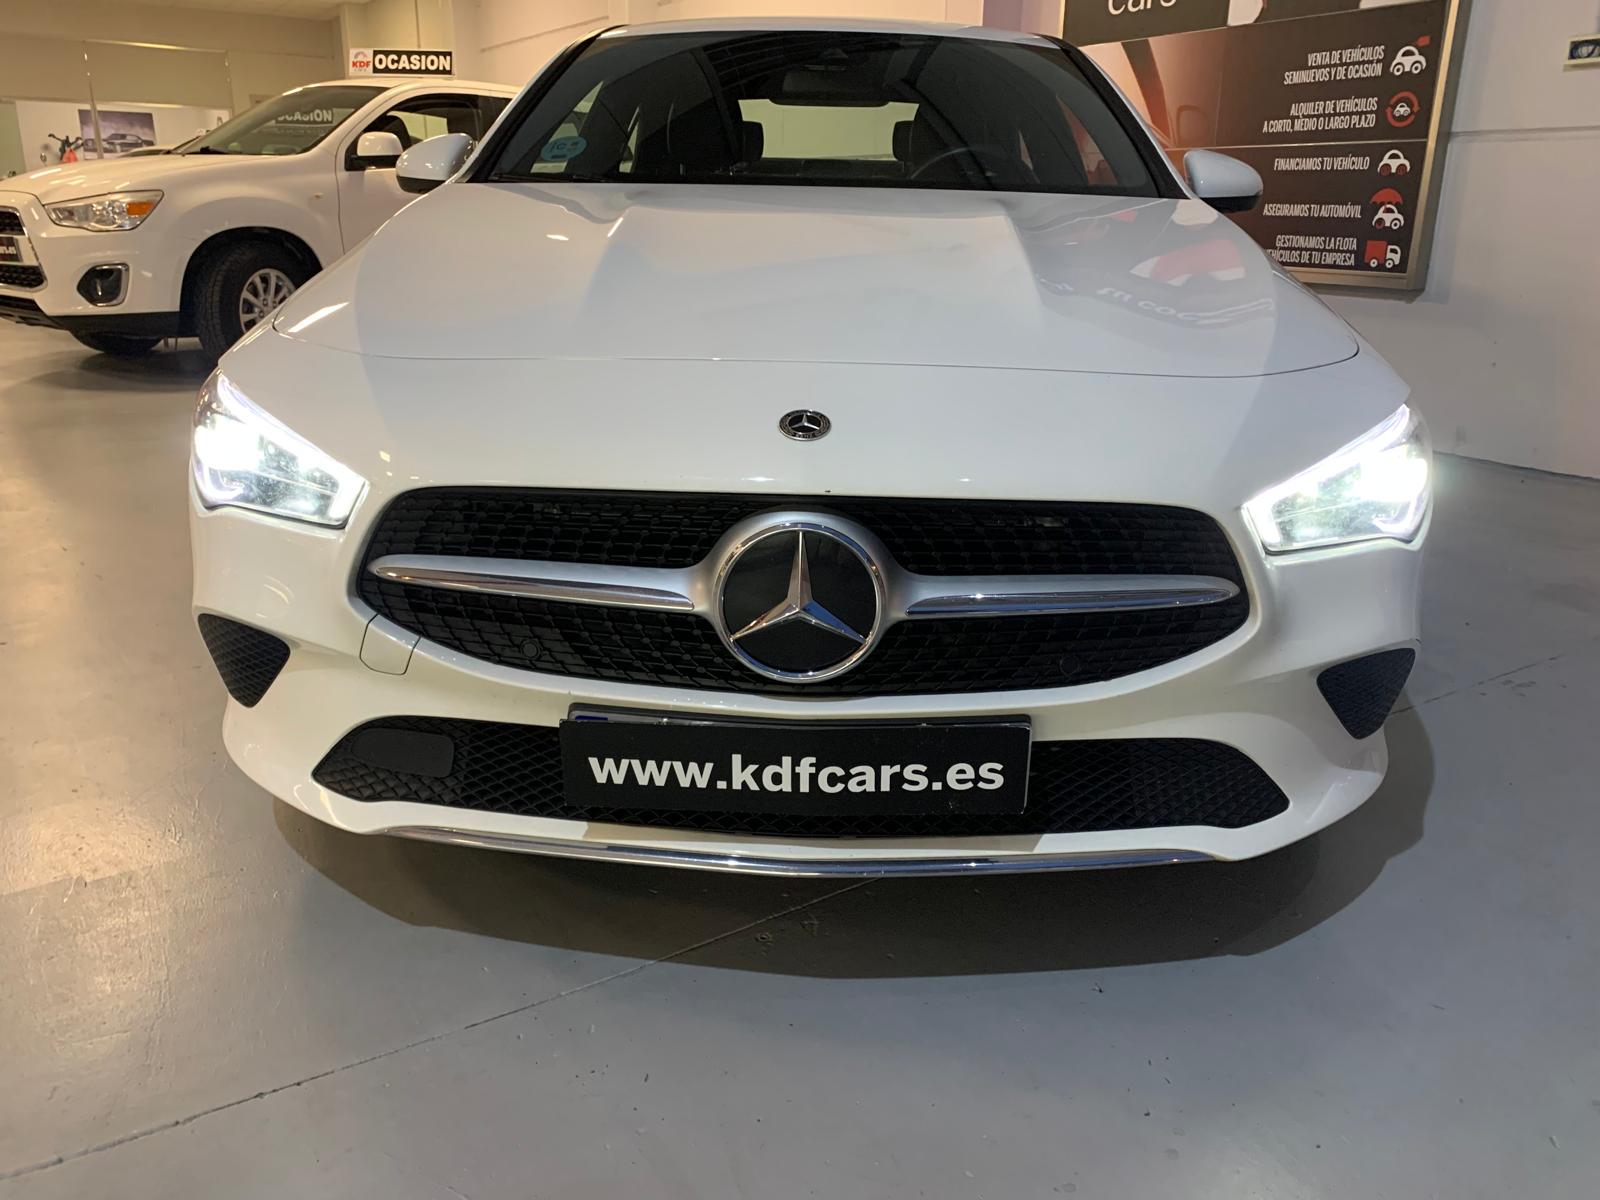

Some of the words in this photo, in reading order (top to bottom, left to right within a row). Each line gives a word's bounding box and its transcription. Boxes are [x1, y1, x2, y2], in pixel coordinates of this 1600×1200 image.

[351, 60, 371, 68] KDF
[374, 54, 451, 70] OCASION
[1307, 51, 1330, 66] VENTA
[1331, 50, 1340, 63] DE
[1340, 45, 1385, 62] VEHÍCULOS
[1284, 68, 1329, 85] SEMINUEVOS
[1330, 67, 1336, 80] Y
[1336, 66, 1347, 80] DE
[1347, 60, 1383, 78] OCASIÓN
[1290, 101, 1324, 118] ALQUILER
[1325, 100, 1335, 114] DE
[1336, 95, 1378, 113] VEHÍCULOS
[1262, 121, 1268, 133] A
[1268, 119, 1293, 133] CORTO,
[1293, 117, 1317, 131] MEDIO
[1318, 117, 1324, 130] O
[1324, 115, 1350, 130] LARGO
[1350, 114, 1376, 128] PLAZO
[1274, 157, 1322, 171] FINANCIAMOS
[1323, 157, 1333, 170] TU
[1333, 153, 1370, 170] VEHÍCULO
[1263, 203, 1311, 217] ASEGURAMOS
[1311, 204, 1320, 217] TU
[1320, 202, 1361, 218] AUTOMÓVIL
[1275, 234, 1325, 249] GESTIONAMOS
[1325, 237, 1335, 249] LA
[1335, 237, 1357, 250] FLOTA
[1301, 251, 1311, 263] DE
[1311, 251, 1321, 264] TU
[1321, 252, 1355, 266] EMPRESA
[588, 753, 1005, 794] www.kdfcars.es
